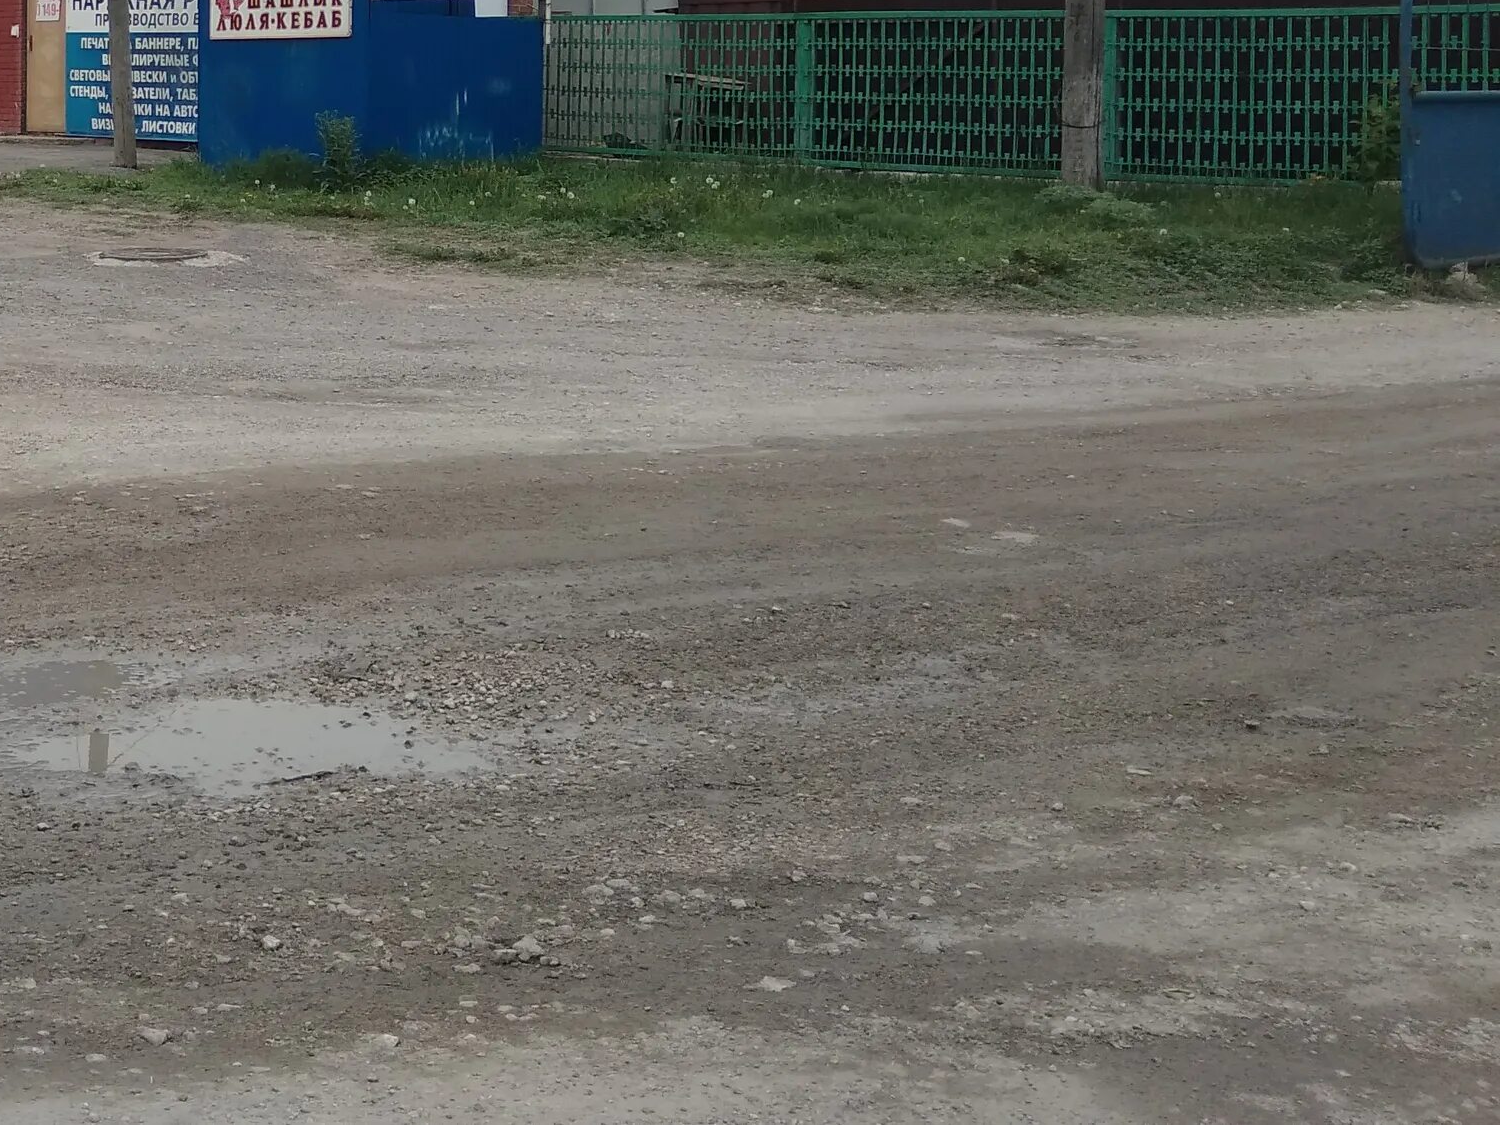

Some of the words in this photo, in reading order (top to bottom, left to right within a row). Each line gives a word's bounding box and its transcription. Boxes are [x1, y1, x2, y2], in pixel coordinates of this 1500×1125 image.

[135, 37, 184, 51] БАННЕРЕ,
[69, 85, 109, 100] СТЕНДЫ,
[155, 103, 171, 117] НА
[141, 120, 196, 135] ЛИСТОВКИ
